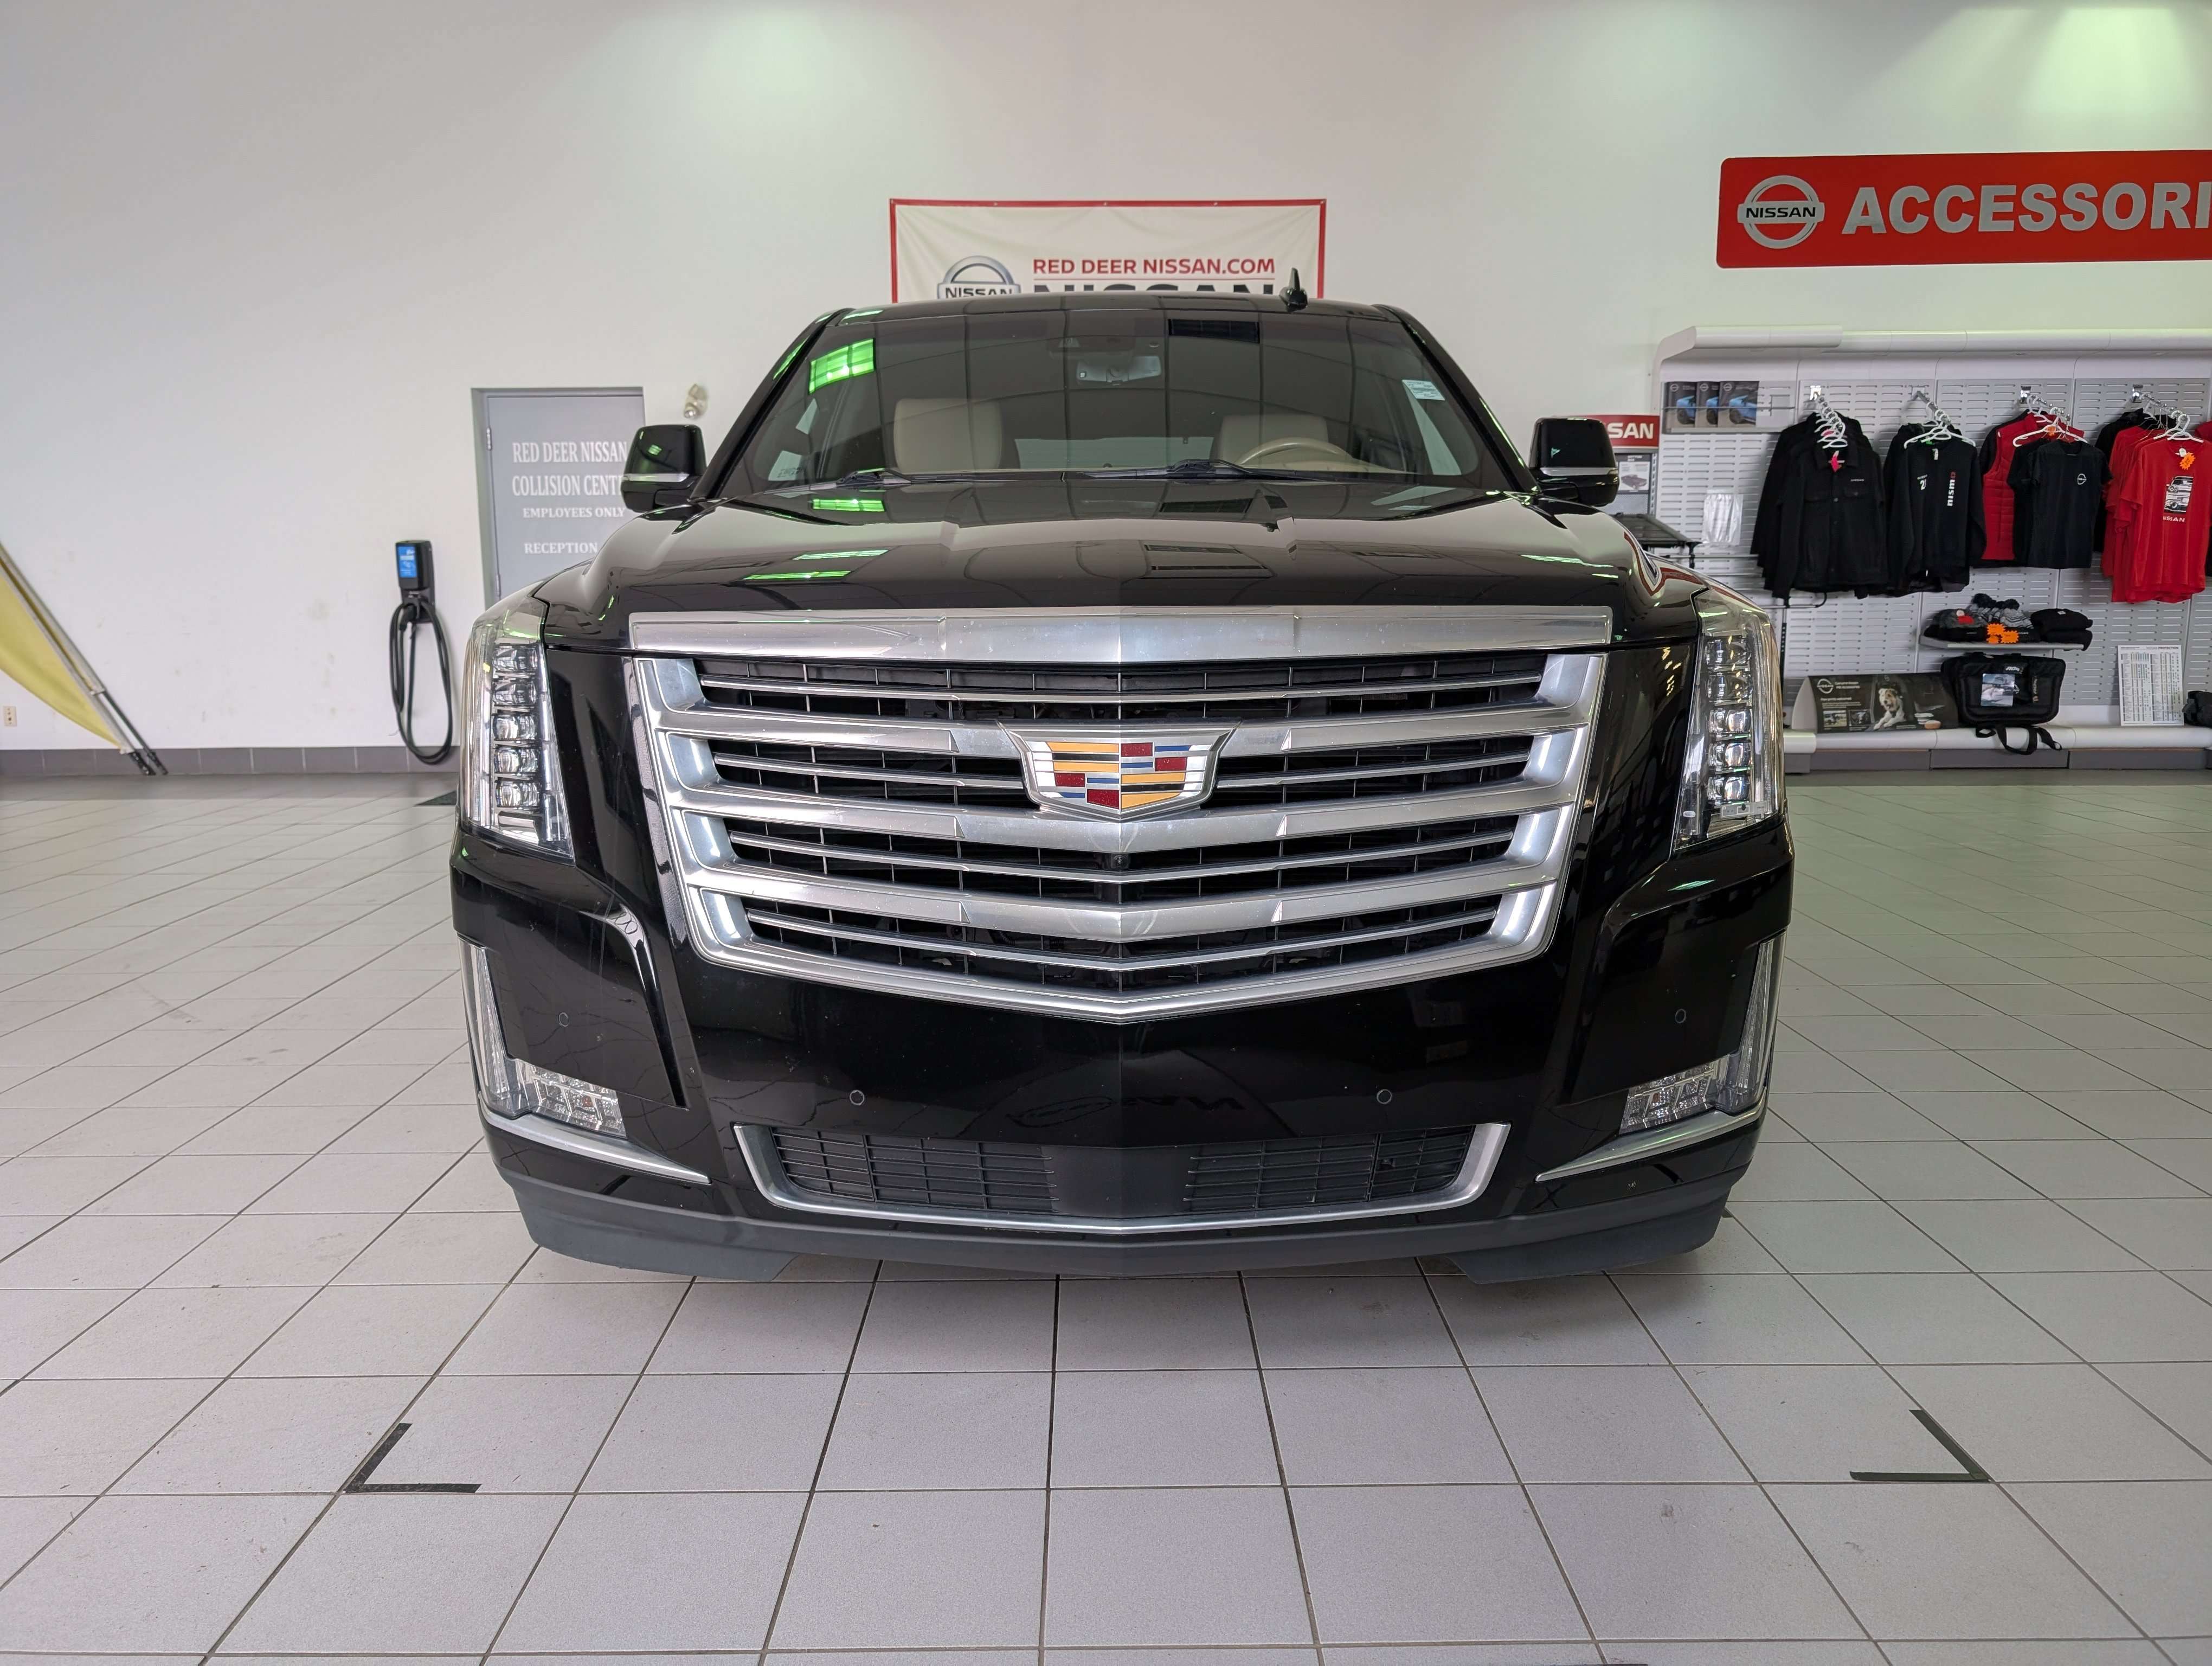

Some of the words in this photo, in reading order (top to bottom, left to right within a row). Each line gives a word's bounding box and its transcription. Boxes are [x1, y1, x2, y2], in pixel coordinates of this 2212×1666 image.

[1746, 207, 1816, 217] NISSAN
[1842, 182, 2212, 234] ACCESSORI
[1033, 259, 1075, 274] RED
[1082, 259, 1136, 274] DEER
[1143, 258, 1274, 274] NISSAN.COM
[1607, 422, 1654, 439] SAN
[512, 443, 539, 462] RED
[543, 442, 578, 462] DEER
[581, 441, 627, 462] NISSAN
[512, 475, 581, 496] COLLISION
[1947, 471, 1956, 507] nismo
[523, 508, 593, 518] EMPLOYEES
[595, 507, 625, 517] ONLY
[525, 543, 597, 554] RECEPTION
